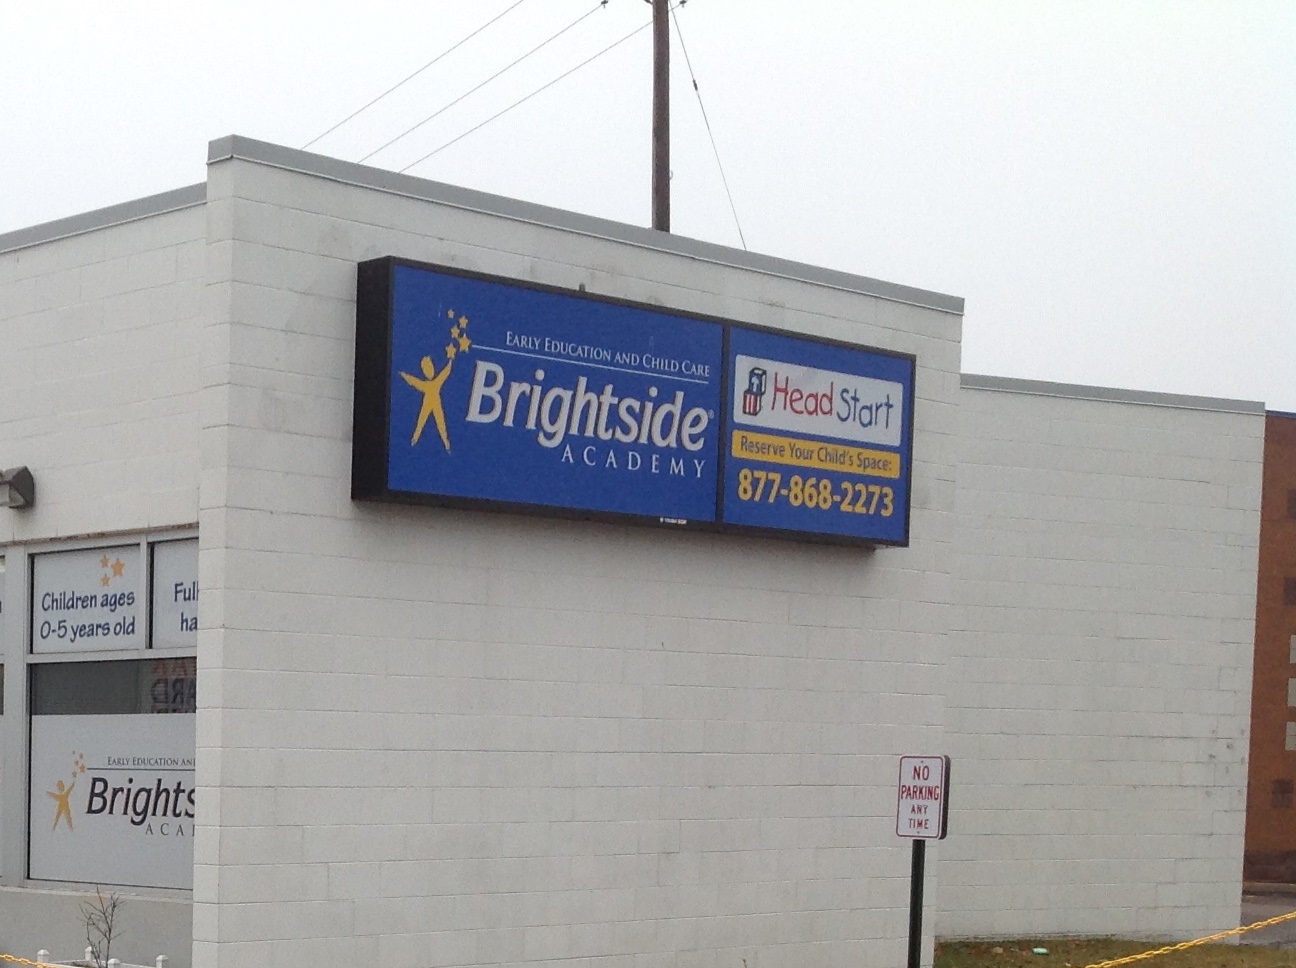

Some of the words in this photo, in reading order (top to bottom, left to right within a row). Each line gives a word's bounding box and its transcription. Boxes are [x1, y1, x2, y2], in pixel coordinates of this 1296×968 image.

[506, 331, 542, 350] EARLY
[545, 337, 611, 362] EDUCATION
[614, 350, 639, 366] AND
[642, 354, 679, 372] CHILD
[681, 360, 710, 377] CARE
[465, 360, 709, 452] Brightside
[771, 372, 834, 416] Head
[837, 387, 894, 430] Start
[561, 444, 705, 478] ACADEMY
[740, 435, 785, 457] Reserve
[789, 442, 814, 460] Your
[817, 447, 853, 466] Child's
[857, 452, 892, 472] Space:
[738, 468, 894, 517] 877-868-2273
[41, 590, 97, 611] Children
[100, 591, 135, 612] ages
[40, 619, 68, 639] 0-5
[69, 622, 110, 643] years
[113, 616, 135, 635] old
[107, 756, 130, 766] EARLY
[132, 757, 178, 766] EDUCATION
[181, 758, 195, 767] AN
[912, 765, 930, 781] NO
[900, 785, 940, 801] PARKING
[910, 804, 928, 815] ANY
[145, 822, 195, 837] ACA
[908, 818, 929, 830] TIME
